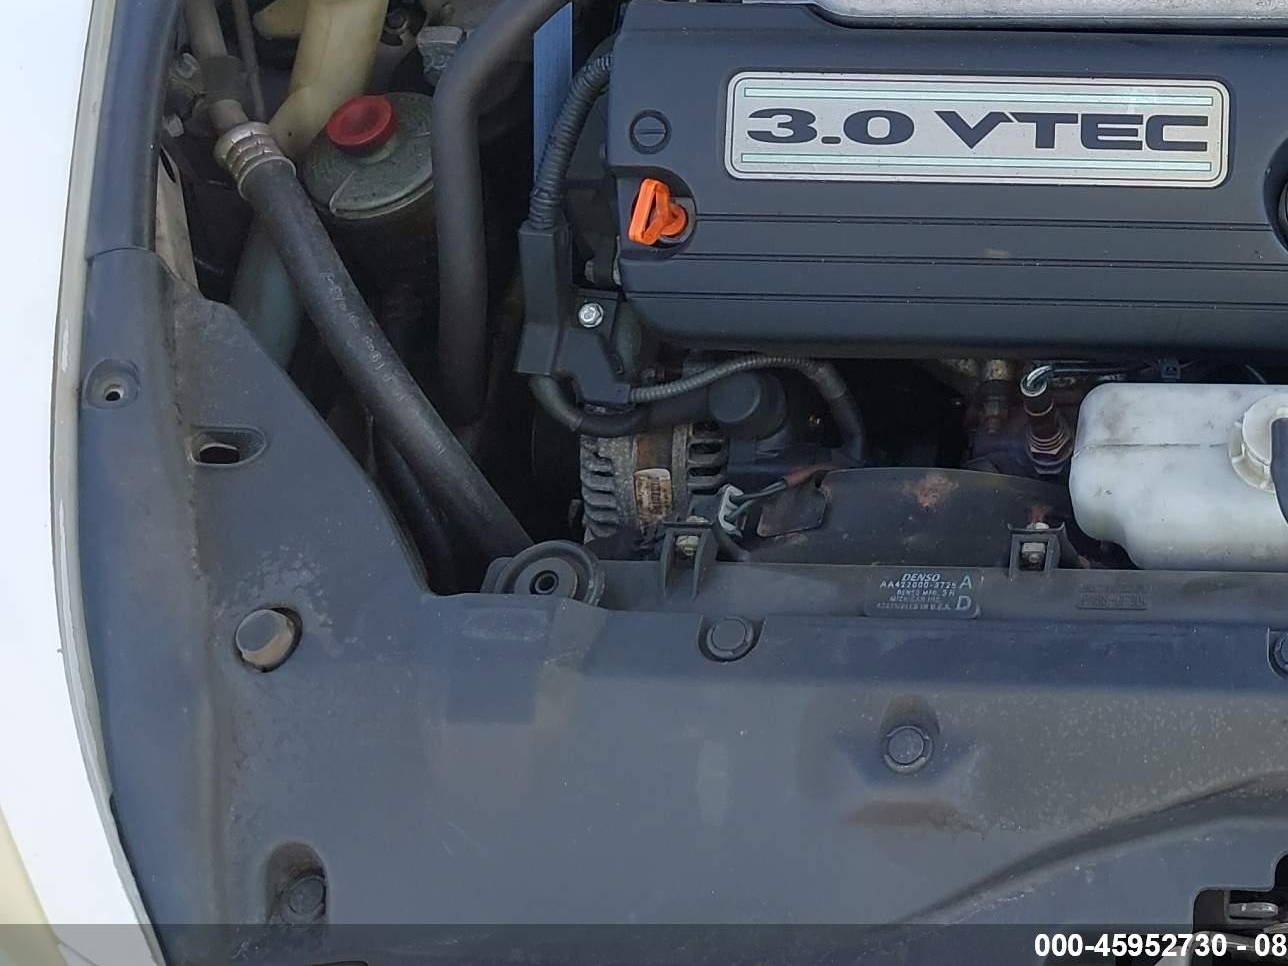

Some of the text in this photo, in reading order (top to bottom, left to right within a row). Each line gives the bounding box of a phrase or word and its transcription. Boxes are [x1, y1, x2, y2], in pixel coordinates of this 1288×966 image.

[746, 106, 1209, 153] 3.0 VTEC
[901, 573, 941, 582] DENSO
[959, 575, 972, 589] A
[955, 595, 972, 611] D
